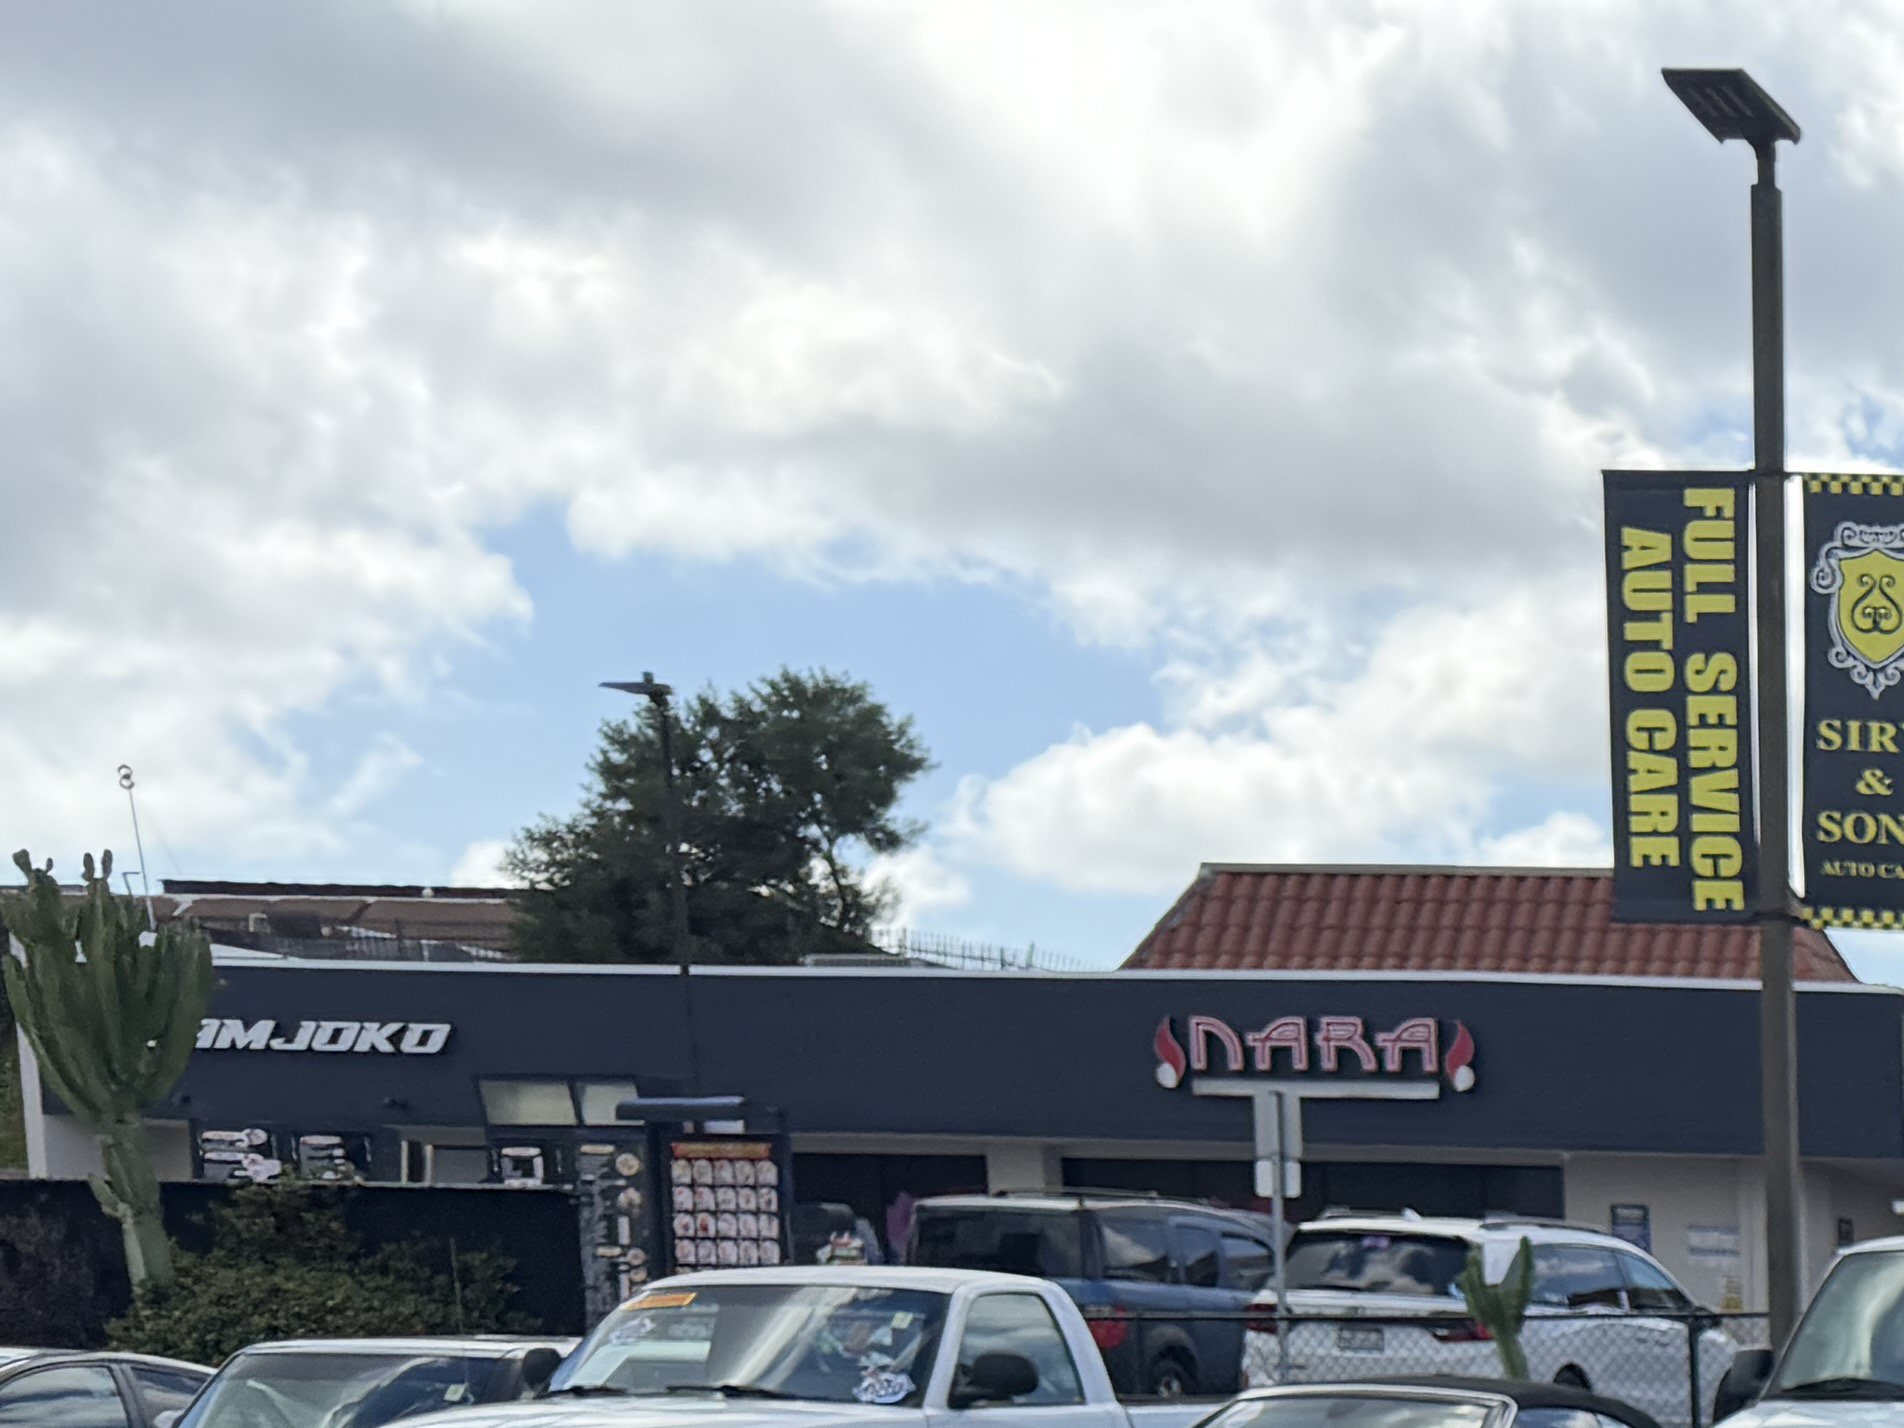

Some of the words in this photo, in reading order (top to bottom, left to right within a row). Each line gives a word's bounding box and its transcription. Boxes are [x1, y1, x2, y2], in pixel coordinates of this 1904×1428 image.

[1620, 527, 1675, 692] AUTO
[1683, 487, 1737, 624] FULL
[1626, 708, 1680, 868] CARE
[1684, 652, 1745, 911] SERVICE
[1856, 769, 1893, 796] &
[1821, 860, 1875, 880] AUTO
[1187, 1014, 1440, 1074] NARA
